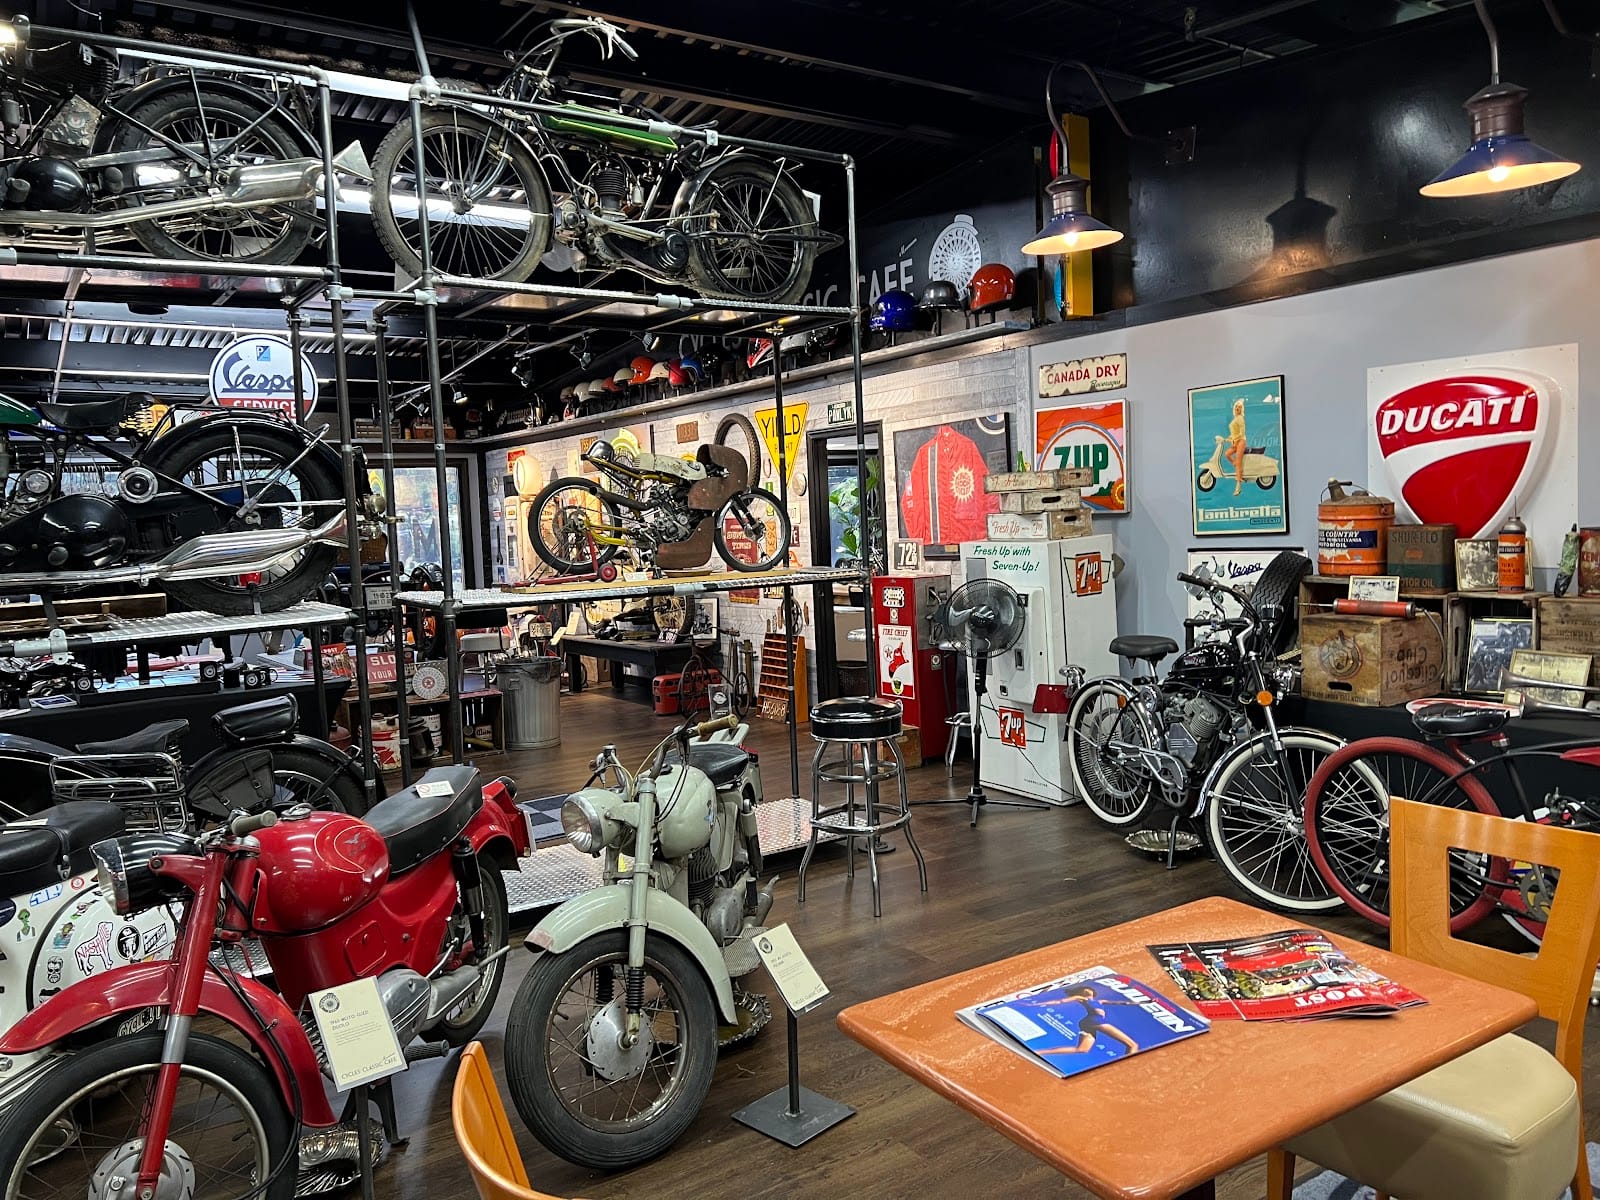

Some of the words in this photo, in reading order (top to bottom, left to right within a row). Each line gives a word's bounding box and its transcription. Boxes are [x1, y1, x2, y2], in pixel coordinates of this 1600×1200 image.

[1047, 368, 1090, 385] CANADA
[1096, 363, 1121, 378] DRY
[1380, 394, 1527, 436] DUCATI
[761, 413, 801, 438] YILD
[1325, 530, 1360, 538] COUNTRY
[1012, 545, 1031, 556] with
[992, 560, 1040, 573] Seven-Up!
[1228, 560, 1265, 579] Vespa
[1400, 577, 1420, 587] OTOR
[370, 653, 396, 667] SLO
[1294, 988, 1366, 1008] POST
